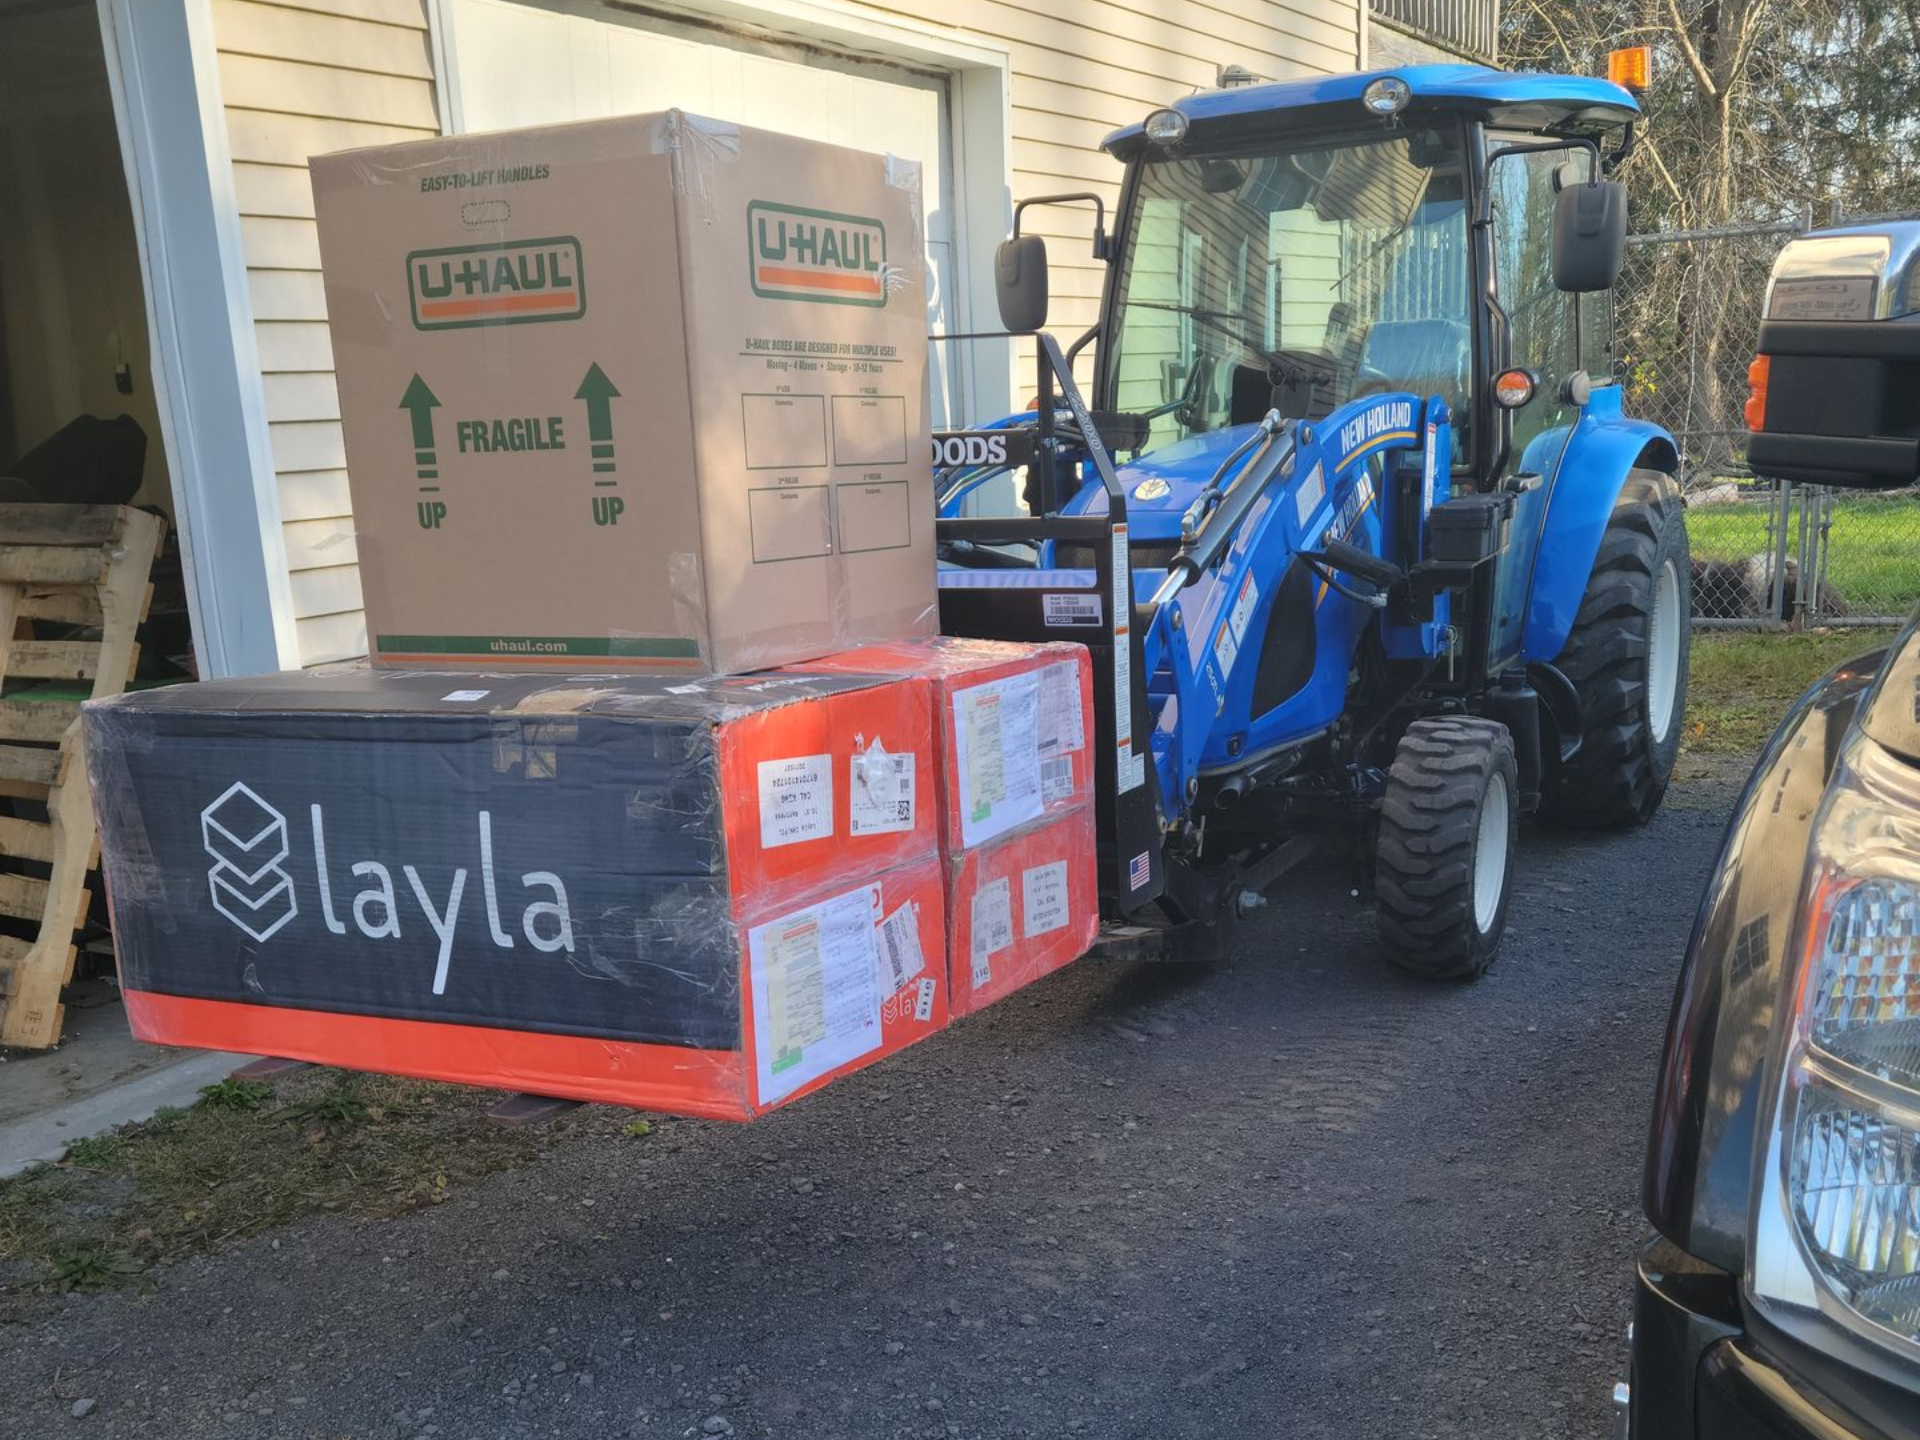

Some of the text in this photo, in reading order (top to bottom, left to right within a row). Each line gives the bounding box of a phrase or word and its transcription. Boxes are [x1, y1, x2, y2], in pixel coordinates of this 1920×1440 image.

[421, 164, 551, 193] EASY-TO-LIFT HANDLES
[758, 217, 880, 272] U-HAUL
[418, 252, 573, 299] U-HAUL
[772, 339, 793, 352] BOXES
[794, 340, 807, 352] ARE
[808, 341, 838, 354] DESIGNED
[838, 343, 851, 354] FOR
[851, 344, 879, 356] MULTIPLE
[766, 359, 788, 372] Moving
[799, 360, 818, 371] Moves
[827, 362, 848, 374] Storage
[868, 363, 883, 374] Years
[457, 417, 566, 453] FRAGILE
[1341, 402, 1411, 455] NEW HOLLAND
[932, 435, 1007, 466] OODS
[417, 501, 447, 530] UP
[592, 497, 624, 526] UP
[491, 639, 568, 653] uhaul.com
[310, 803, 576, 996] layla
